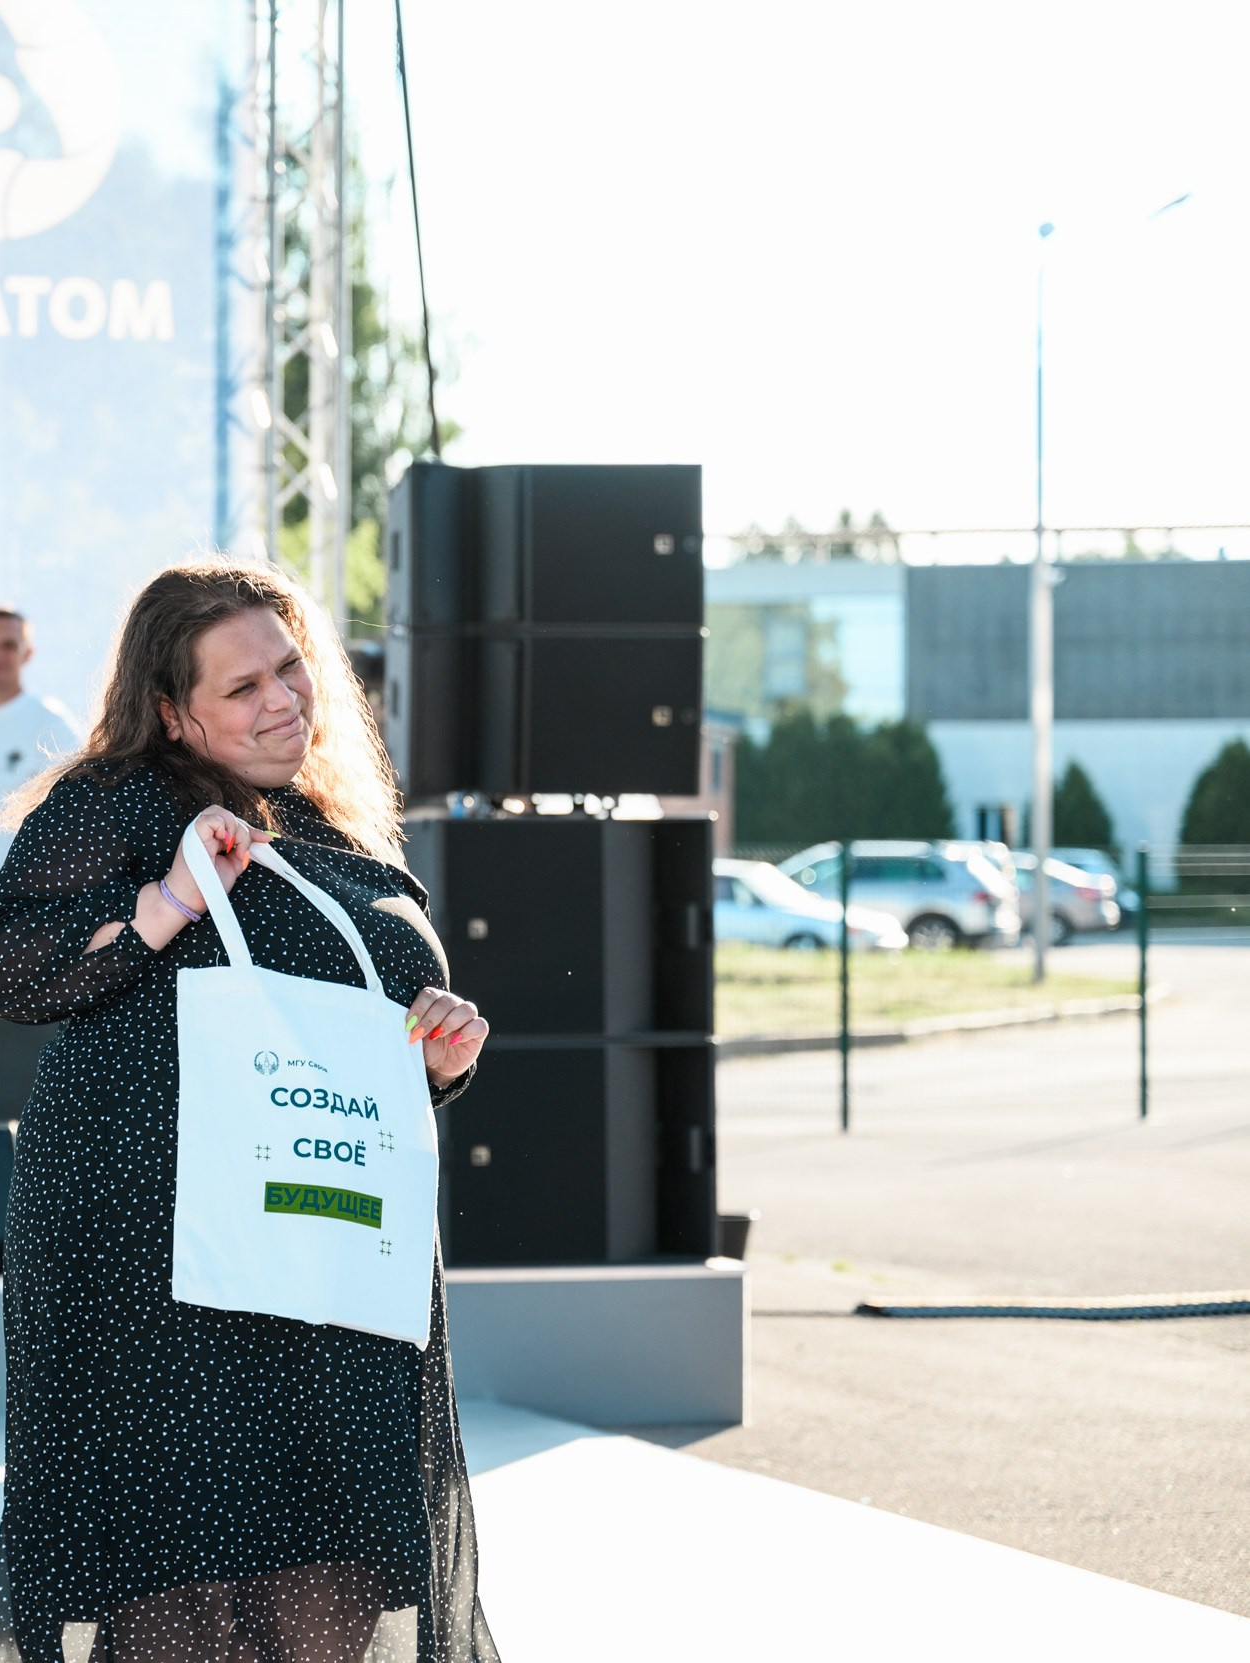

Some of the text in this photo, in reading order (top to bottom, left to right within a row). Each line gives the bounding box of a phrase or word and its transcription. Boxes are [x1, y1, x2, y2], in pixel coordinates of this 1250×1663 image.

[270, 1087, 380, 1121] СОЗДАЙ
[293, 1138, 366, 1167] СВОЁ
[266, 1186, 381, 1221] БУДУЩЕЕ
